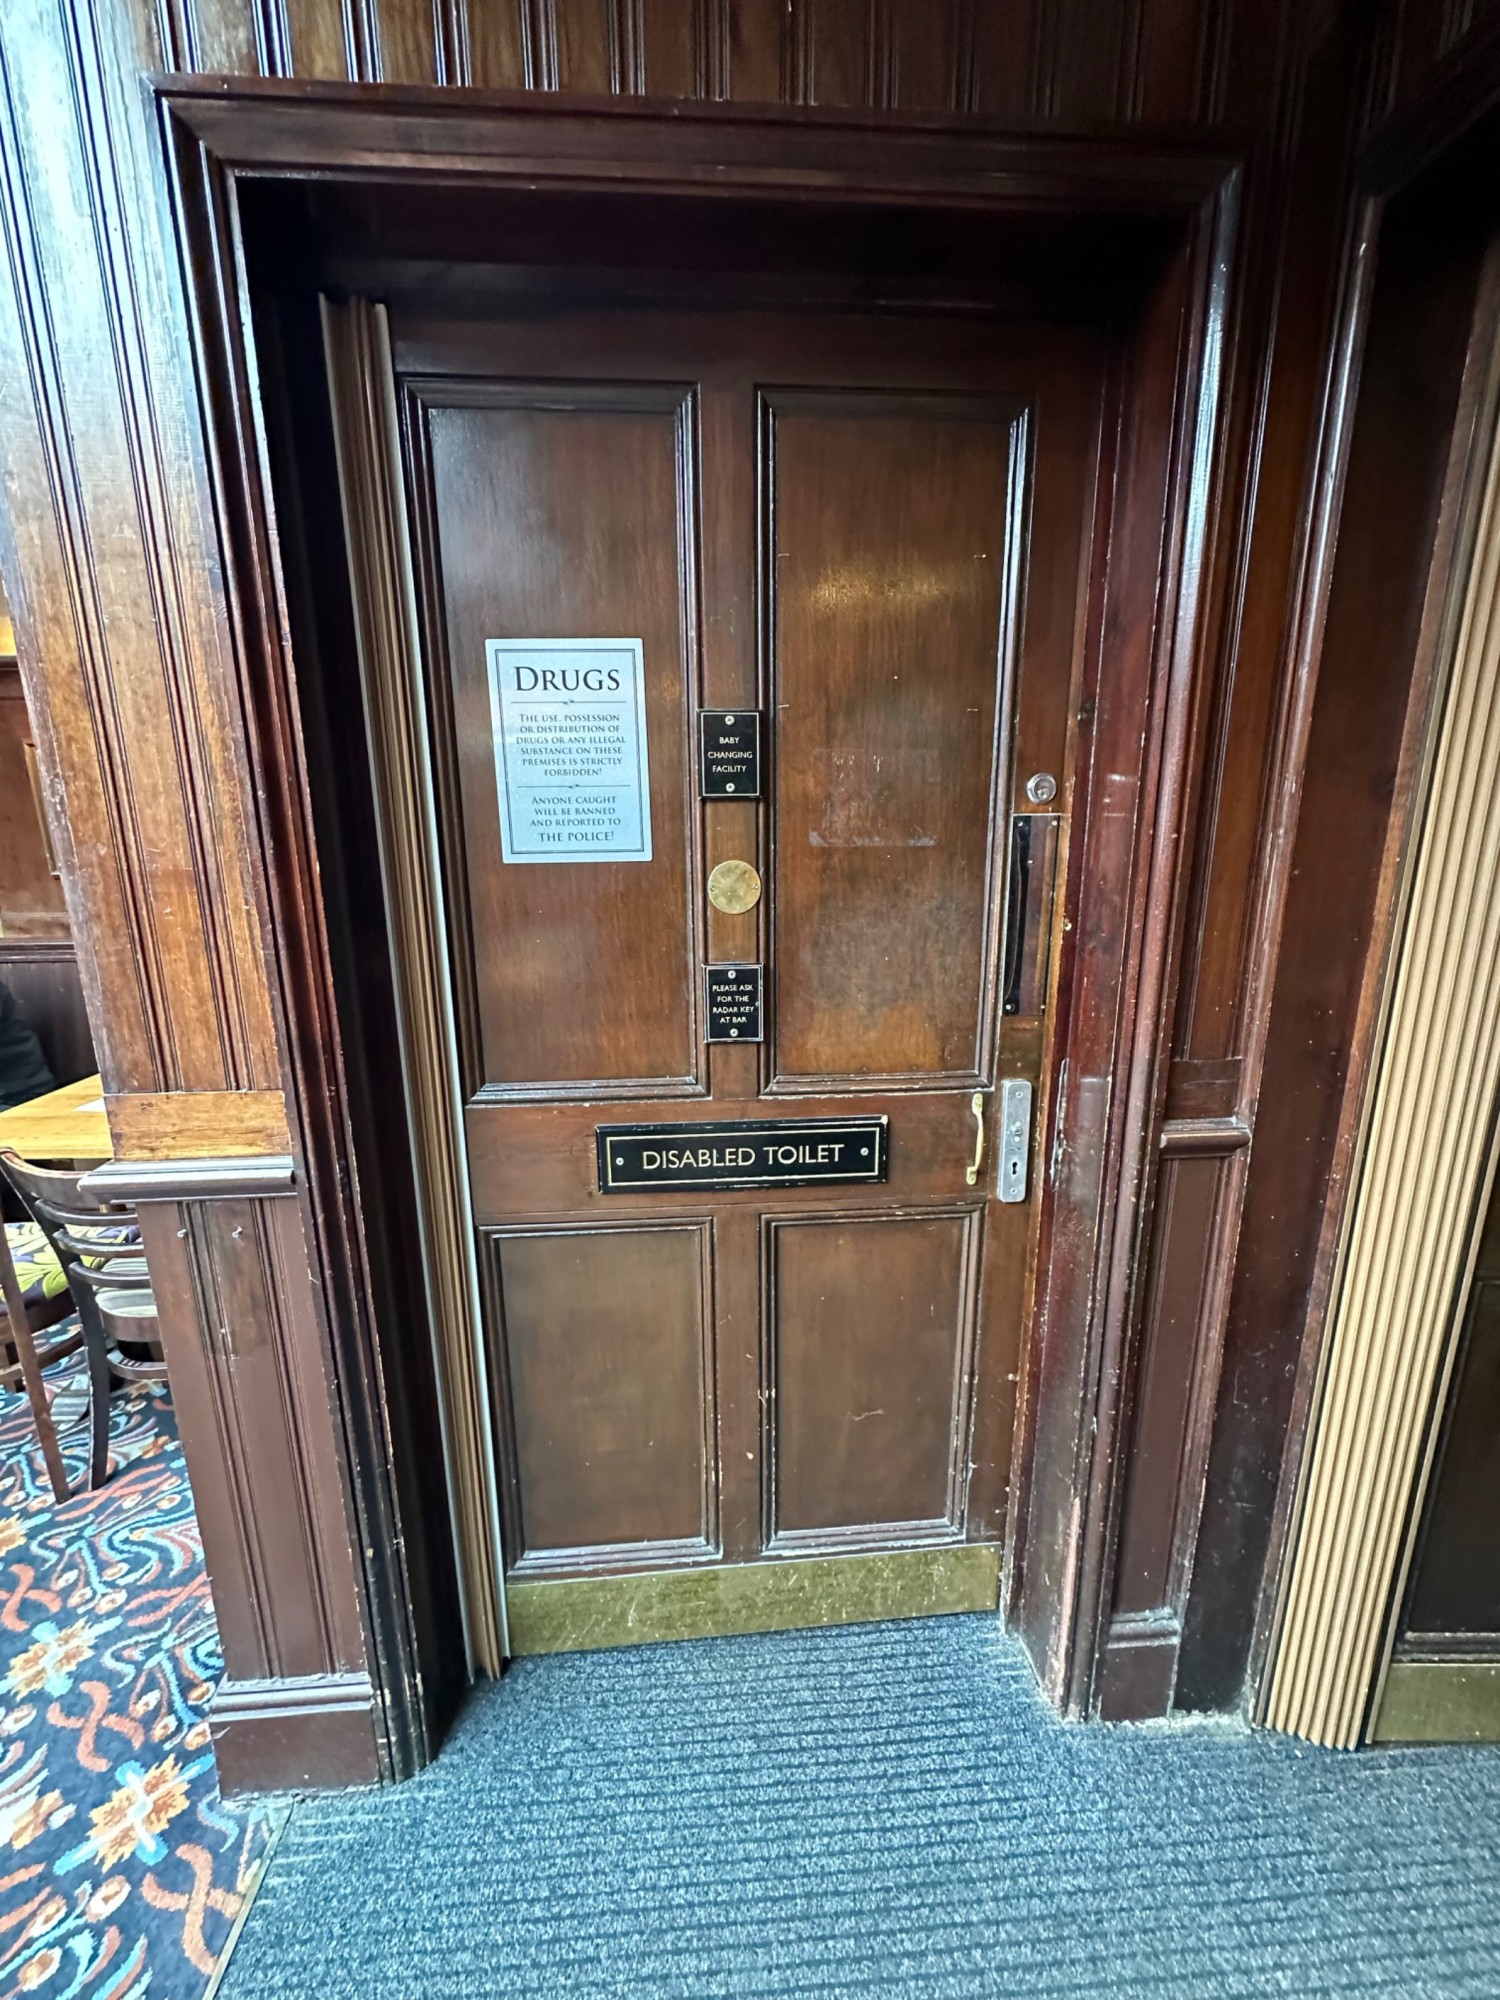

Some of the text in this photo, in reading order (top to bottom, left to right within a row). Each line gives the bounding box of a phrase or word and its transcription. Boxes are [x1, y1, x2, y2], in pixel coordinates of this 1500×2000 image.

[513, 666, 621, 692] DRUGS
[519, 714, 538, 722] THE
[564, 714, 620, 722] POSSESSION
[520, 725, 621, 734] OR DISTRIBUTION OF
[516, 737, 549, 745] DRUGS
[568, 736, 587, 744] ANY
[521, 747, 573, 755] SUBSTANCE
[576, 747, 591, 755] ON
[707, 751, 753, 759] CHANGING
[522, 758, 566, 766] PREMISES
[581, 757, 623, 765] STRICTLY
[544, 768, 602, 776] FORBIDDEN!
[712, 765, 747, 773] FACILITY
[532, 796, 617, 805] ANYONE CAUGHT
[534, 808, 558, 816] WILL
[575, 807, 616, 815] BANNED
[530, 819, 552, 827] AND
[607, 818, 621, 826] TO
[538, 831, 614, 842] THE POLICE!
[642, 1144, 845, 1169] DISABLED TOILET
